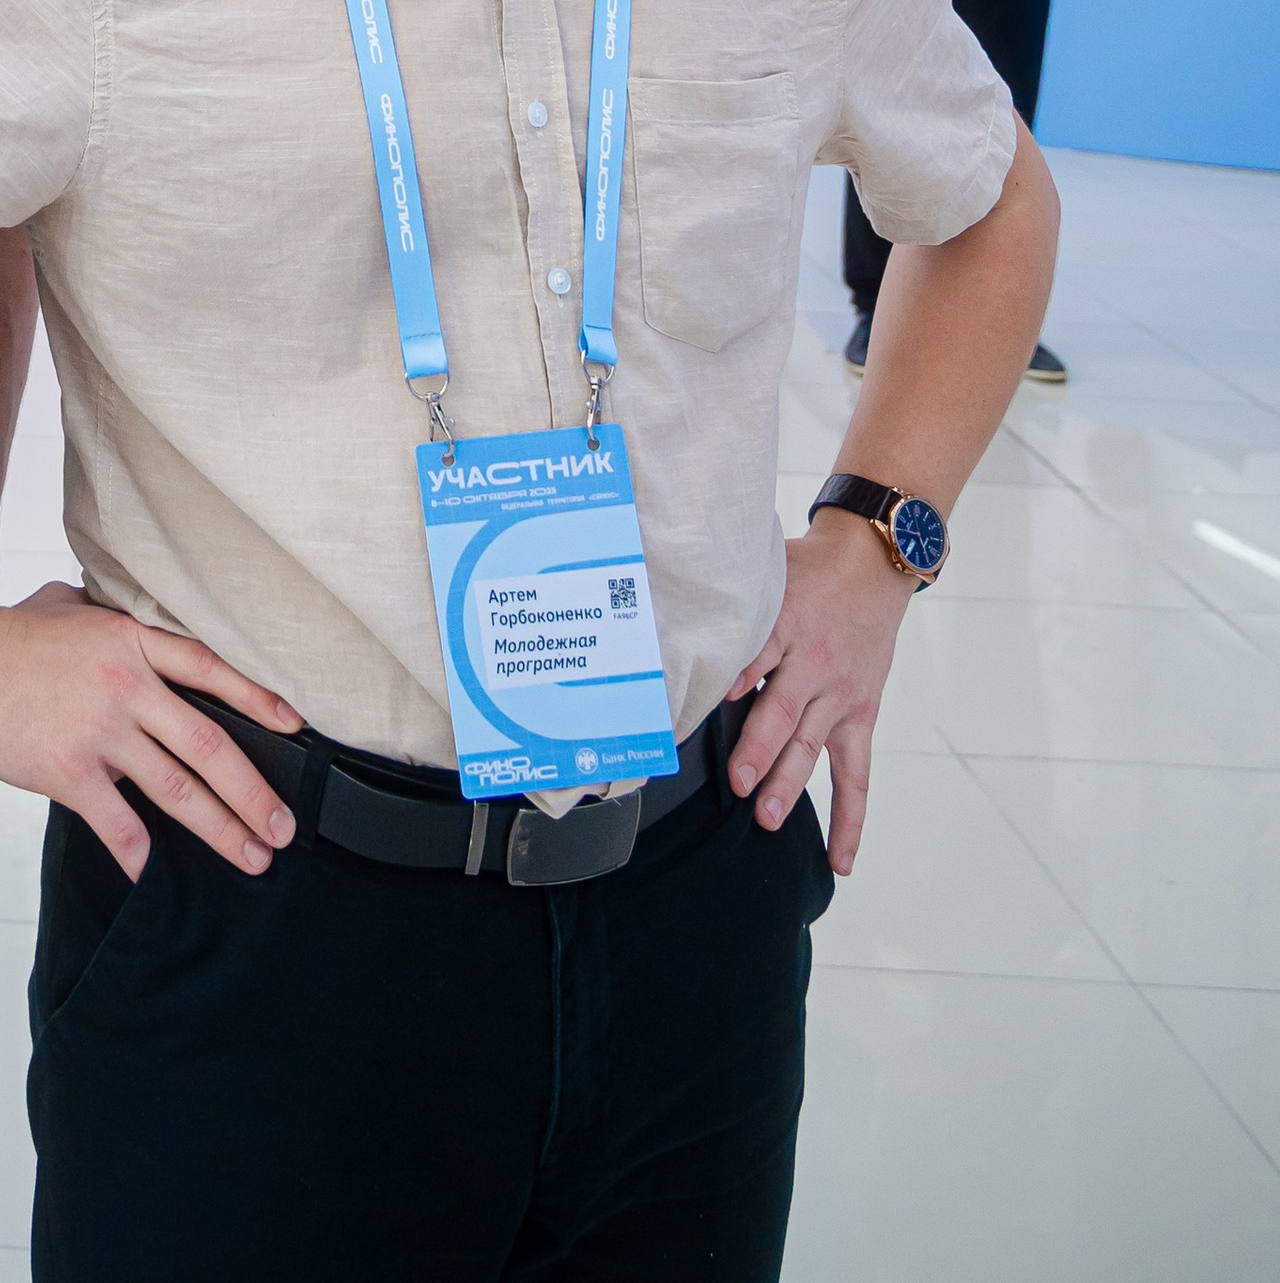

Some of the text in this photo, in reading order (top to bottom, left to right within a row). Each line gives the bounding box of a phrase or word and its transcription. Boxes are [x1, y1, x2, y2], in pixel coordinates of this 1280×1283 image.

[380, 92, 415, 253] ФИНОПОЛИС
[595, 88, 614, 242] ФИНОПОЛИС
[427, 451, 615, 493] УЧАСТНИК
[488, 589, 538, 607] Артем
[490, 607, 603, 629] Горбоконенко
[494, 635, 598, 655] Молодежная
[496, 655, 588, 678] программа
[464, 756, 531, 776] ФИНО
[602, 748, 664, 765] Банк России
[480, 765, 559, 786] ПОЛИС
